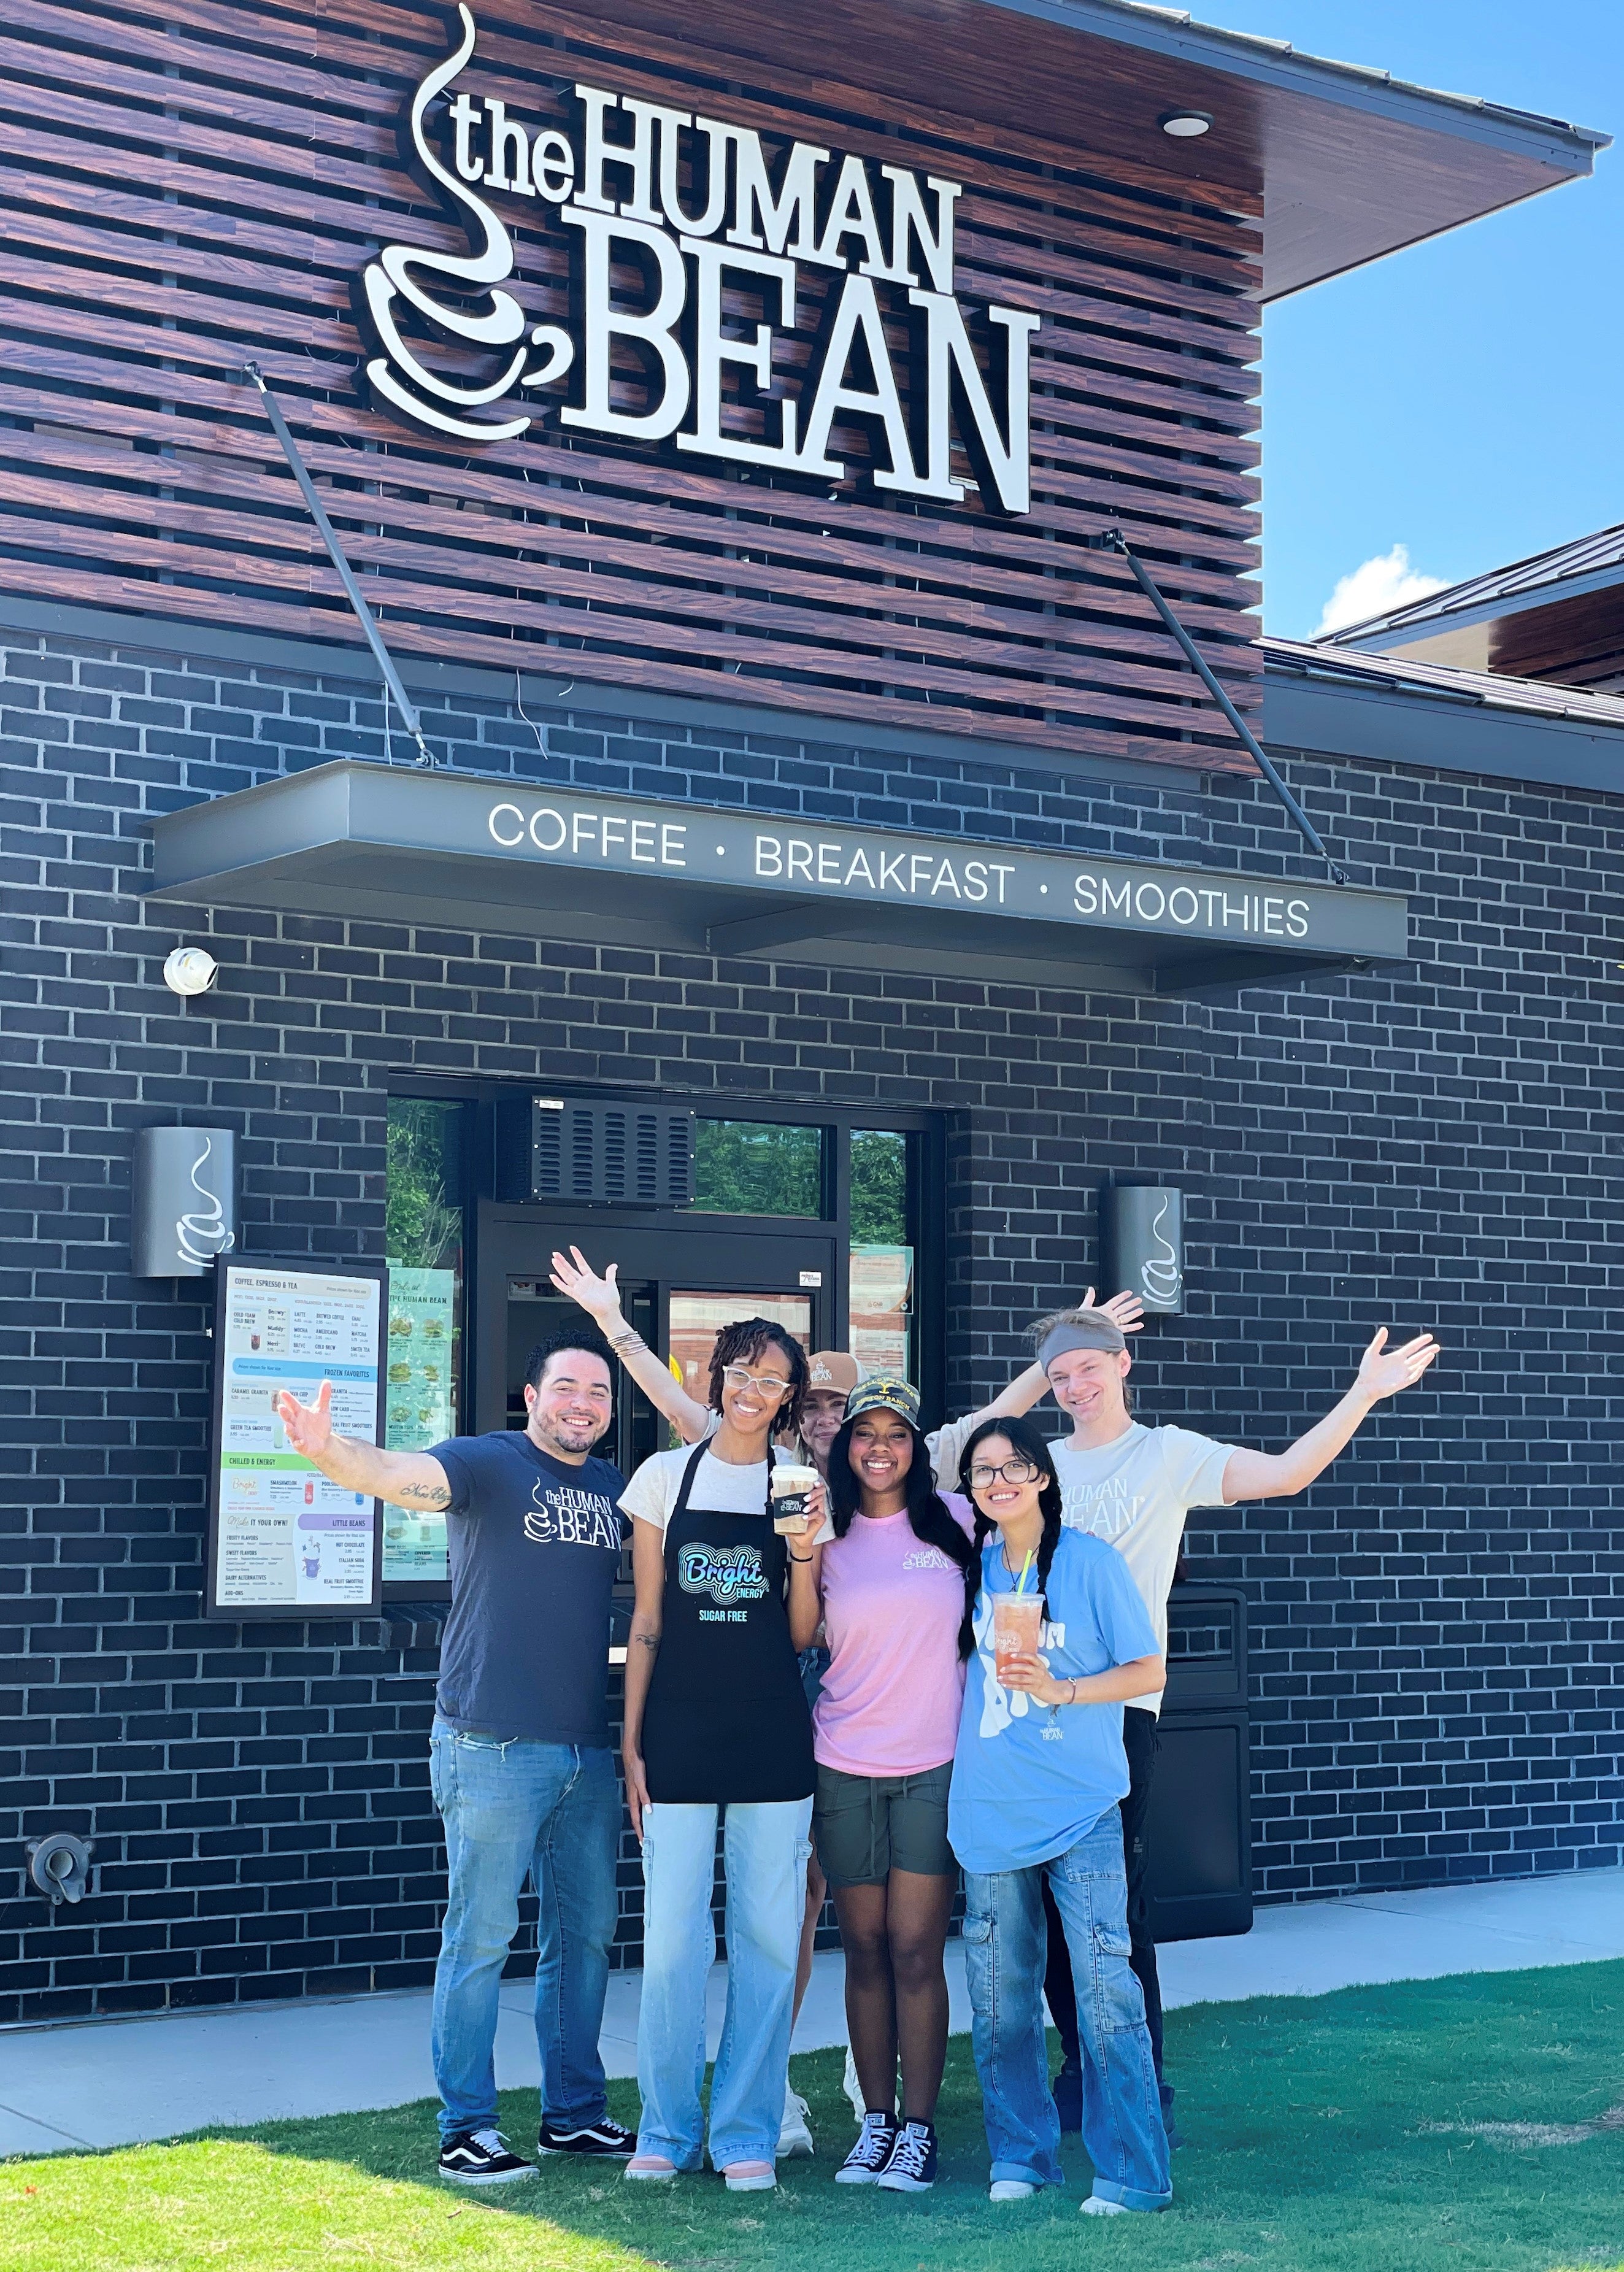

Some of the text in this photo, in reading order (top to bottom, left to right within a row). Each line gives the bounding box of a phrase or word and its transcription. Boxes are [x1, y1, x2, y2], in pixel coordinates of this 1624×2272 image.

[450, 83, 961, 295] the HUMAN
[561, 204, 1041, 514] BEAN
[488, 803, 1310, 938] COFFEE BREAKFAST SMOOTHIES
[344, 1369, 369, 1378] FAVORITES
[811, 1373, 832, 1382] BEAN
[886, 1396, 910, 1411] RANCH
[545, 1486, 612, 1515] the HUMAN
[555, 1505, 622, 1552] BEAN
[915, 1556, 949, 1569] BEAN
[686, 1554, 763, 1594] Bright
[736, 1588, 764, 1598] ENERGY
[699, 1609, 748, 1622] SUGAR FREE
[1042, 1731, 1064, 1740] BEAN
